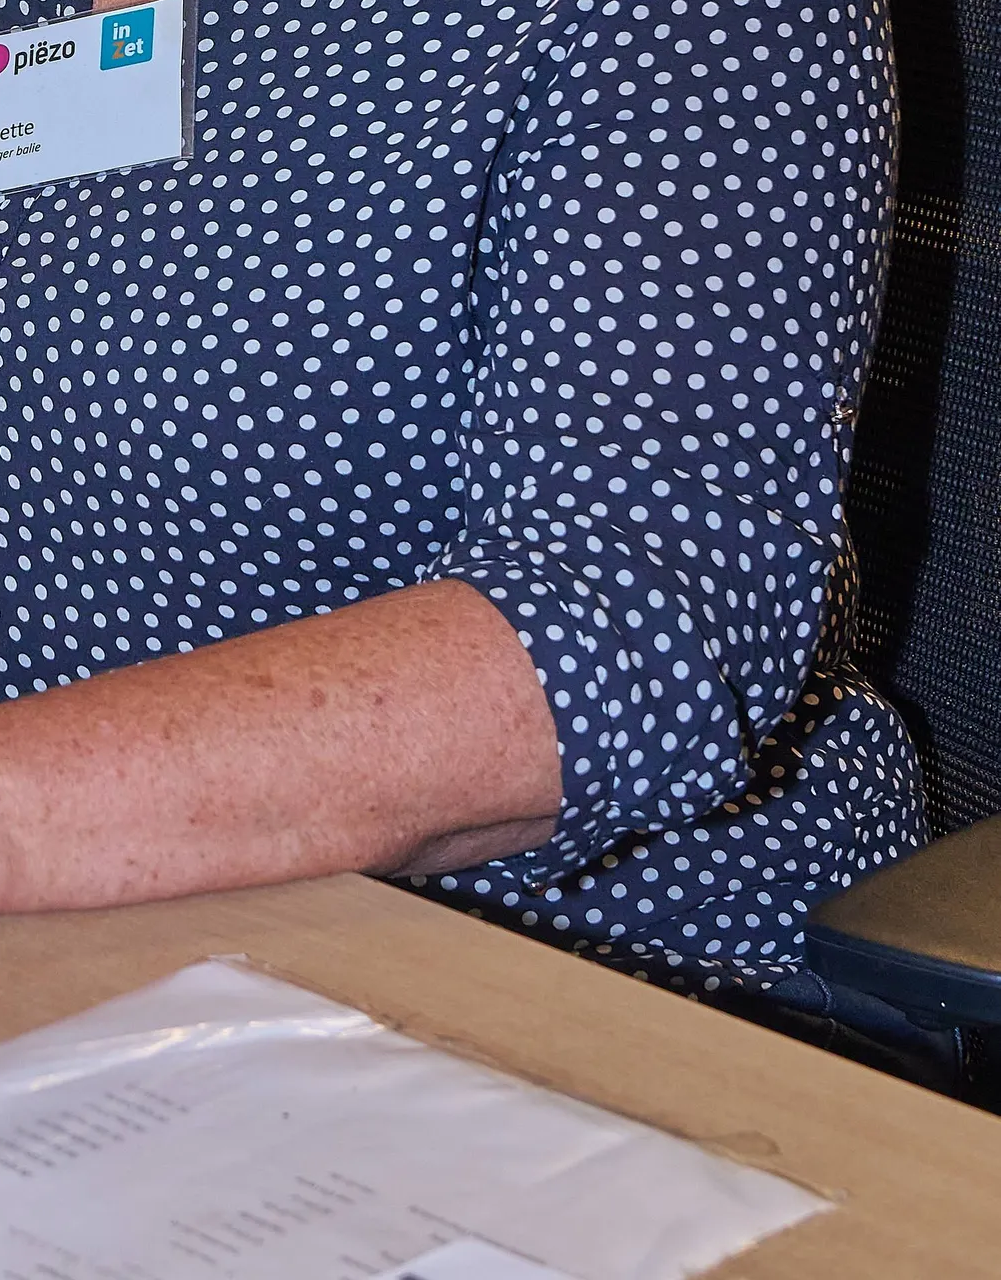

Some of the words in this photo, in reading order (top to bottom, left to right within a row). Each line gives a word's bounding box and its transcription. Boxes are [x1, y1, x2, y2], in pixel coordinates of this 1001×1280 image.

[113, 23, 131, 40] in
[14, 41, 75, 75] piëzo
[16, 143, 41, 156] balie
